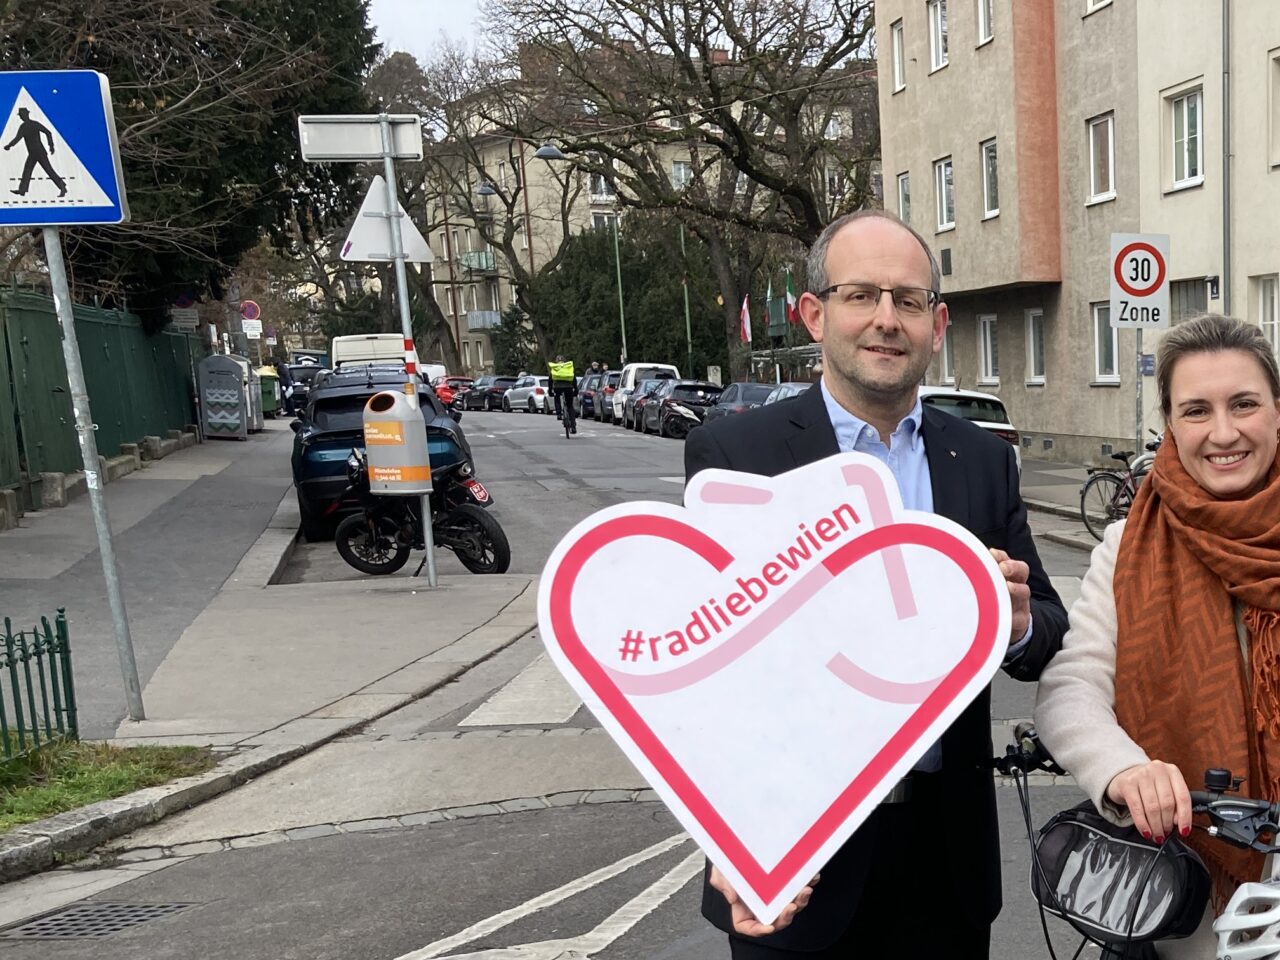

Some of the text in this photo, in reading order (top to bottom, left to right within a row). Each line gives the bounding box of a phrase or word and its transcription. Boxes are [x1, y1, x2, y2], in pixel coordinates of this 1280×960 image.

[1129, 257, 1151, 282] 30
[1118, 300, 1160, 322] Zone
[618, 502, 861, 663] #radliebewien
